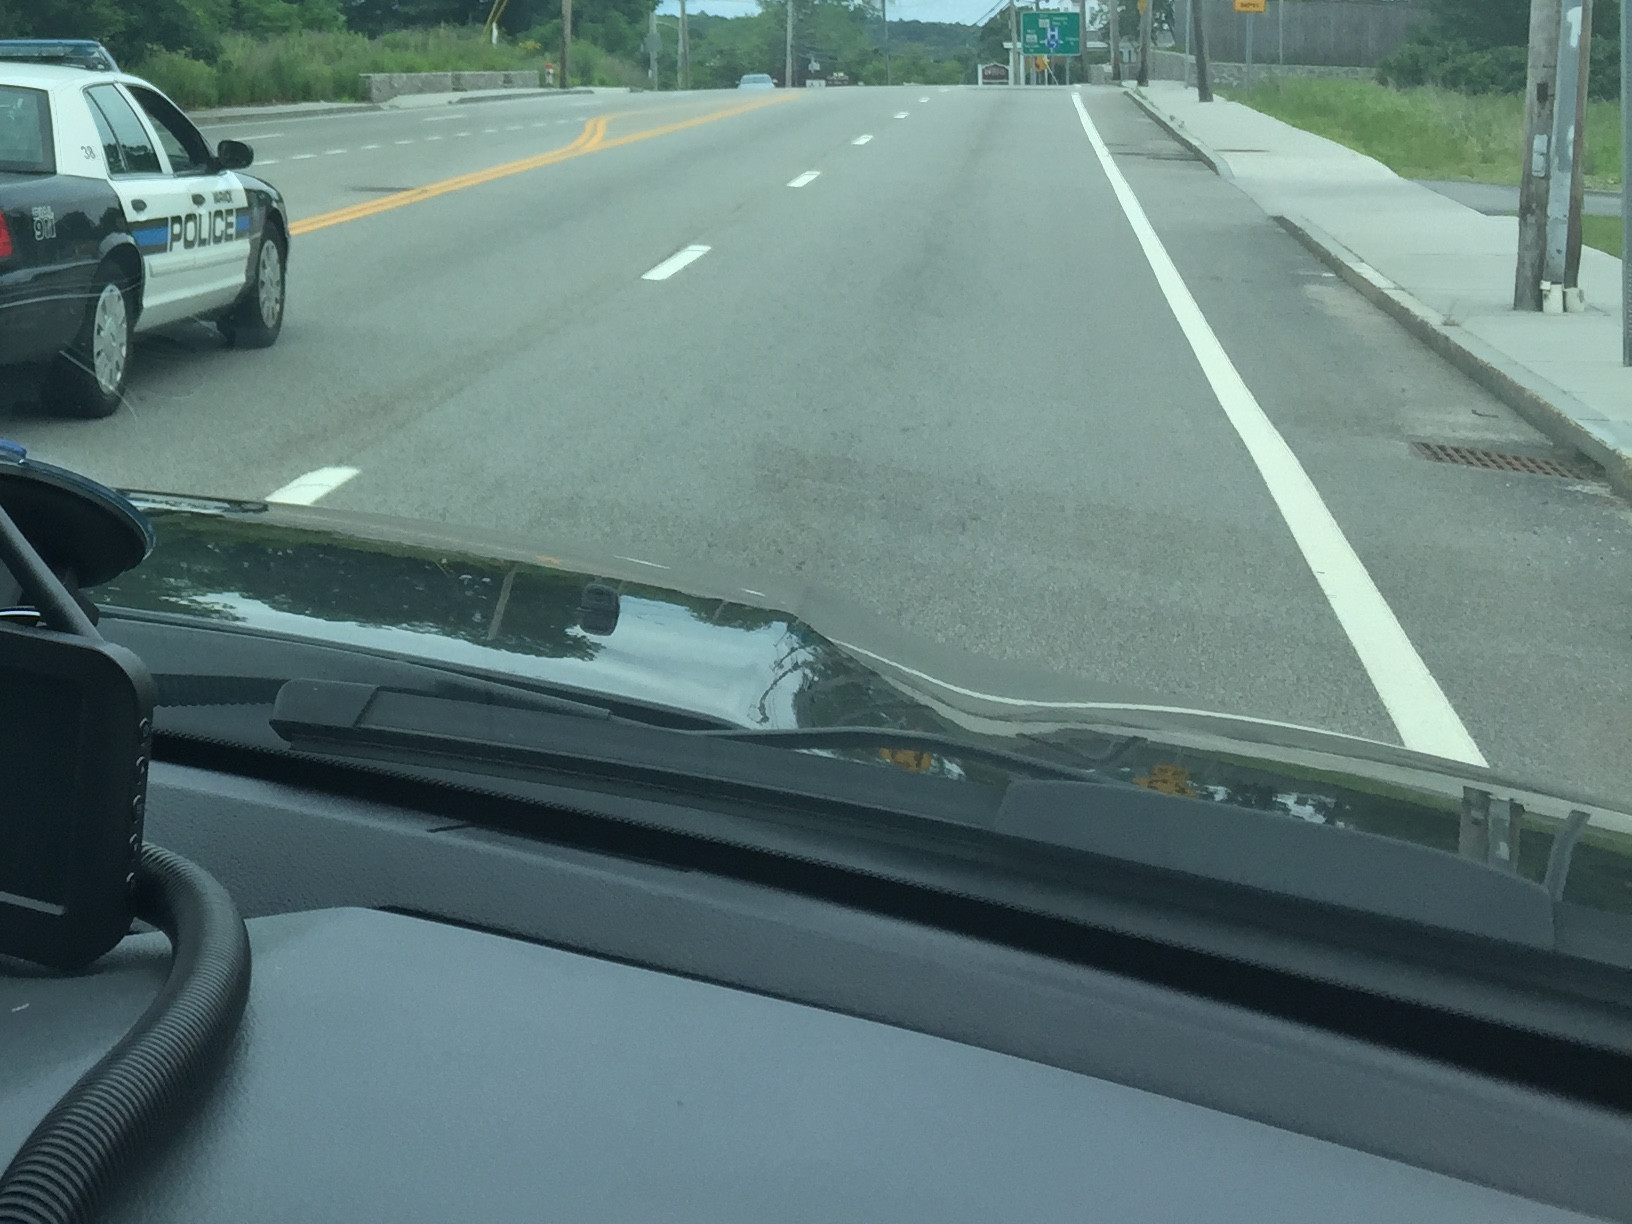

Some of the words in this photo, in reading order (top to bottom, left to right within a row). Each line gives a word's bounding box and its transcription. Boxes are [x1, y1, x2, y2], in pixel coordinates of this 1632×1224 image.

[80, 145, 96, 161] 38
[33, 217, 56, 241] 911
[169, 208, 235, 252] POLICE
